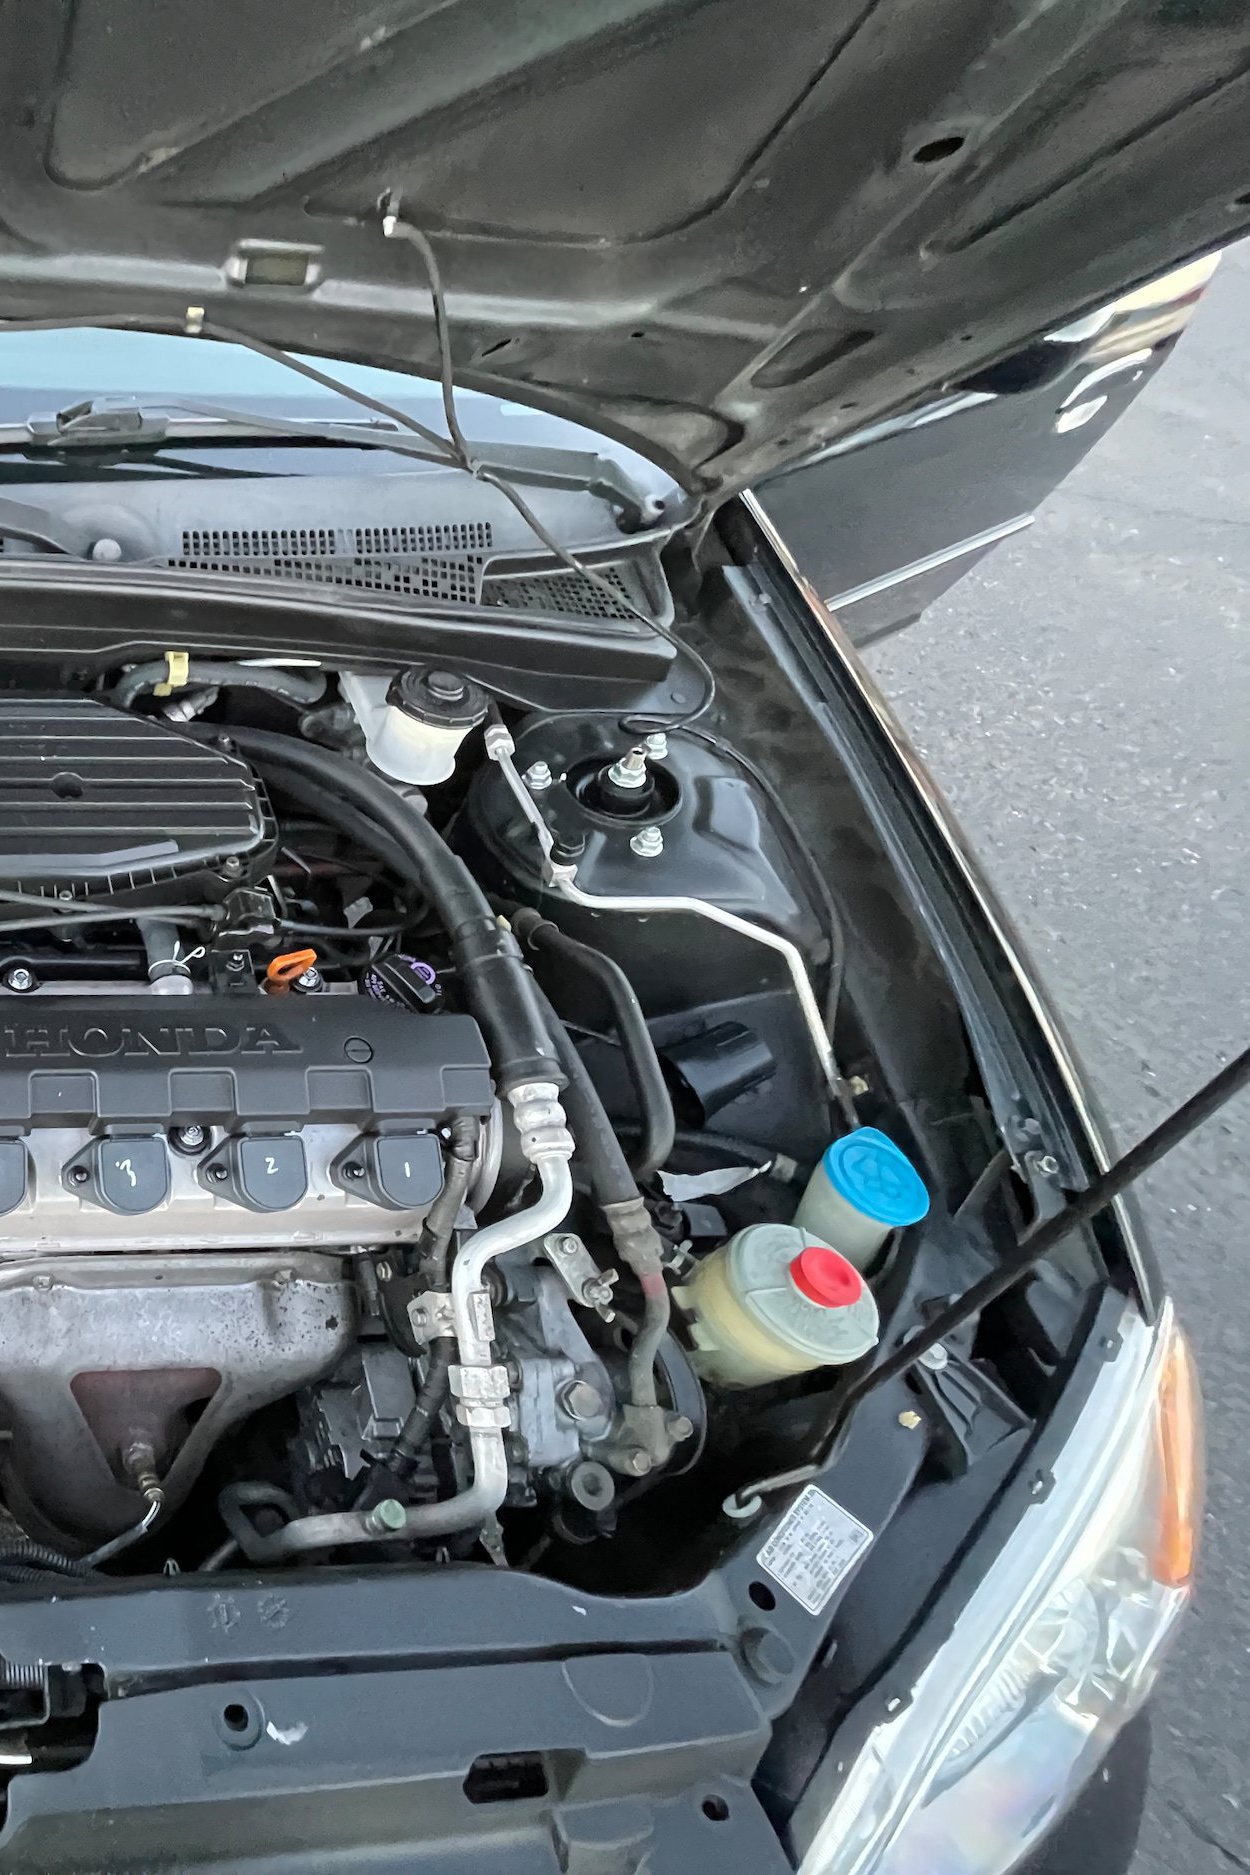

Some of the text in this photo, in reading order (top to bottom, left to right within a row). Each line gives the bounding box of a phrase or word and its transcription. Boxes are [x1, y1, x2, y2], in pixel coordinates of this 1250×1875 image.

[4, 1027, 304, 1057] HONDA
[265, 1157, 279, 1174] 2
[404, 1161, 411, 1178] 1
